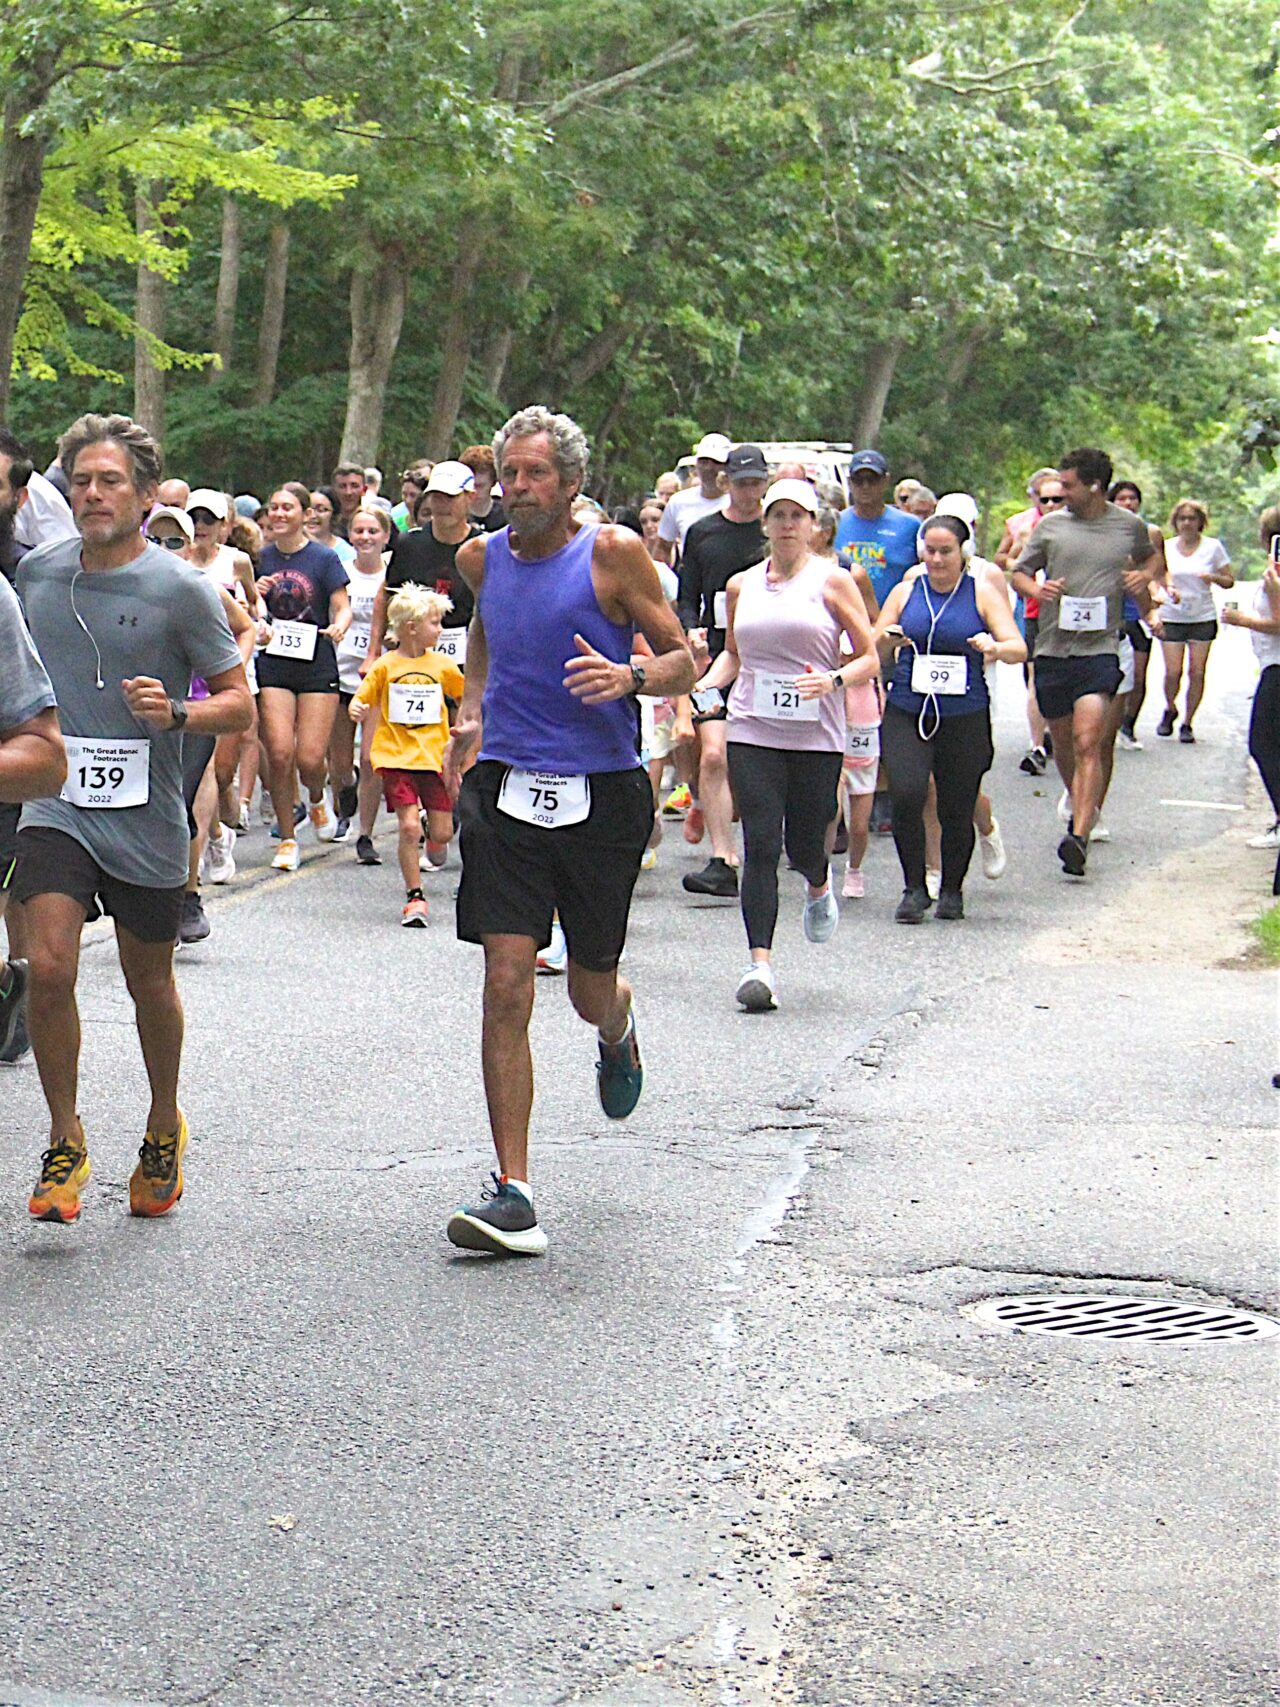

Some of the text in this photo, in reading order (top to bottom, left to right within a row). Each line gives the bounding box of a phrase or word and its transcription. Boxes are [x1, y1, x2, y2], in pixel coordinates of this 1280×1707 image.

[1072, 610, 1091, 622] 24
[280, 635, 302, 648] 133
[930, 670, 950, 684] 99
[406, 700, 424, 713] 74
[772, 692, 800, 708] 121
[851, 736, 869, 748] 54
[78, 766, 124, 790] 139
[528, 787, 558, 811] 75
[532, 814, 554, 824] 2022
